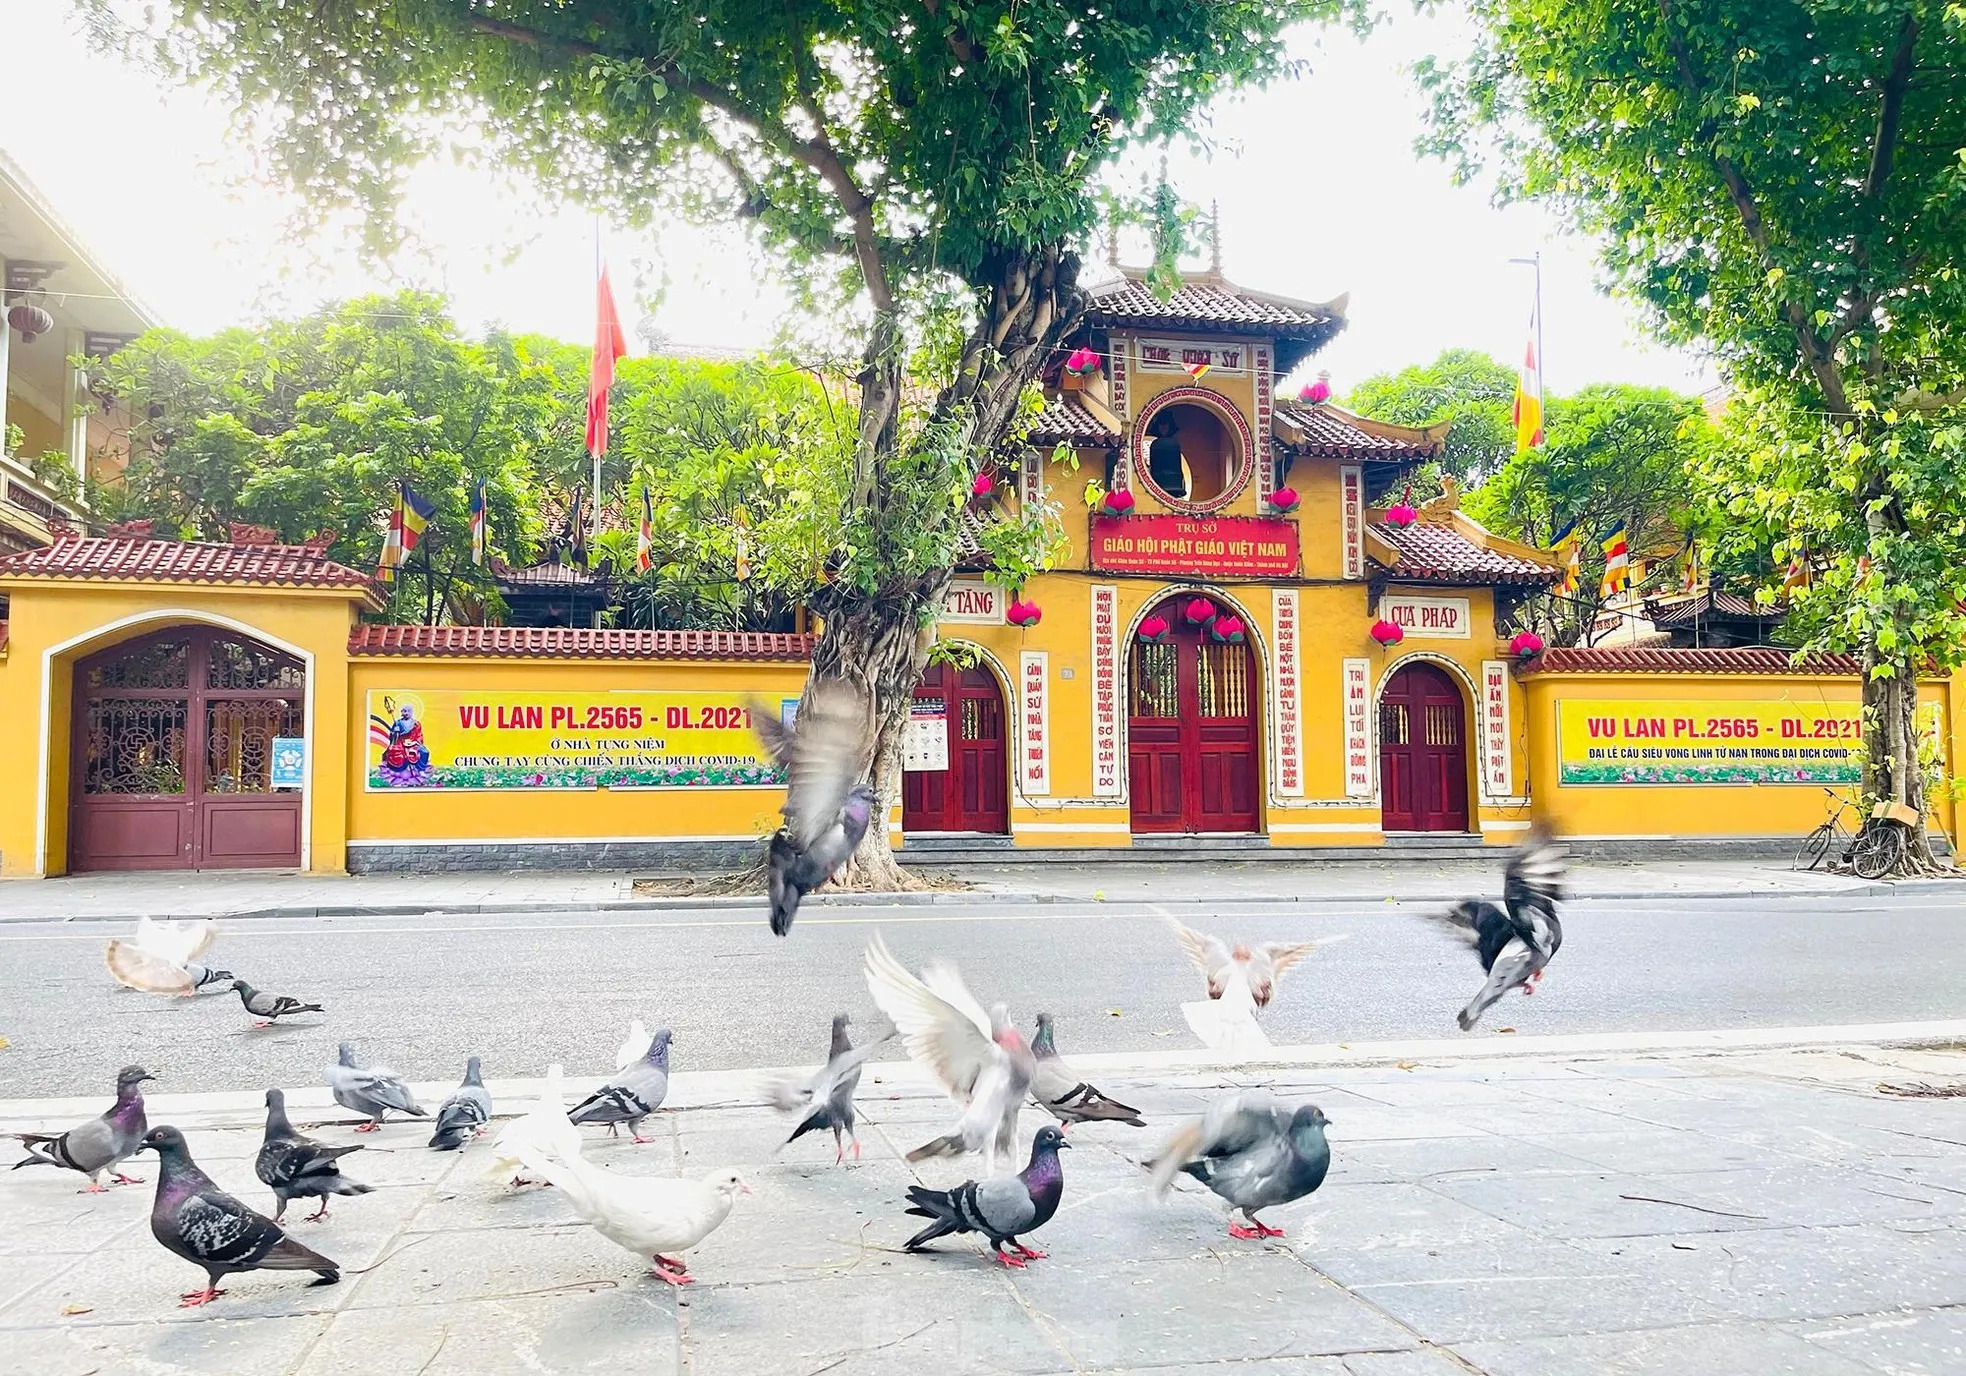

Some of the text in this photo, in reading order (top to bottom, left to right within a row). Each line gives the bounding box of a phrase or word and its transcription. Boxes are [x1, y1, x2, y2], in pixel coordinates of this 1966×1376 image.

[1176, 520, 1217, 535] TRỤ SỞ
[1103, 535, 1287, 559] GIÁO HỘI PHẬT GIÁO VIỆT NAM
[953, 588, 993, 614] TĂNG
[1421, 606, 1457, 629] PHÁP
[1349, 670, 1364, 682] TRI
[1027, 697, 1042, 709] SỨ
[1350, 704, 1364, 716] LUI
[459, 706, 489, 729] VU
[498, 706, 543, 729] LAN
[551, 706, 643, 729] PL.2565
[666, 707, 752, 729] DL.2021
[1027, 712, 1042, 725] NHÀ
[1098, 725, 1114, 736] SƠ
[1350, 718, 1364, 732] TỚI
[1588, 718, 1616, 738] VU
[1623, 718, 1666, 738] LAN
[1673, 718, 1759, 738] PL.2565
[1781, 719, 1861, 739] DL.2021
[550, 737, 665, 752] Ở NHÀ TỤNG NIỆM
[454, 752, 756, 768] CHUNG TAY CÙNG CHIẾN THẮNG DỊCH COVID-19
[1589, 748, 1605, 760] ĐẠI
[1642, 746, 1663, 759] SIÊU
[1665, 748, 1690, 759] VONG
[1692, 748, 1713, 759] LINH
[1729, 748, 1748, 760] NẠN
[1751, 748, 1780, 759] TRONG
[1782, 748, 1798, 760] ĐẠI
[1800, 748, 1821, 760] DỊCH
[1823, 748, 1862, 759] COVID-
[1099, 764, 1114, 776] TỰ
[1099, 778, 1114, 786] DO
[1351, 773, 1366, 784] PHA
